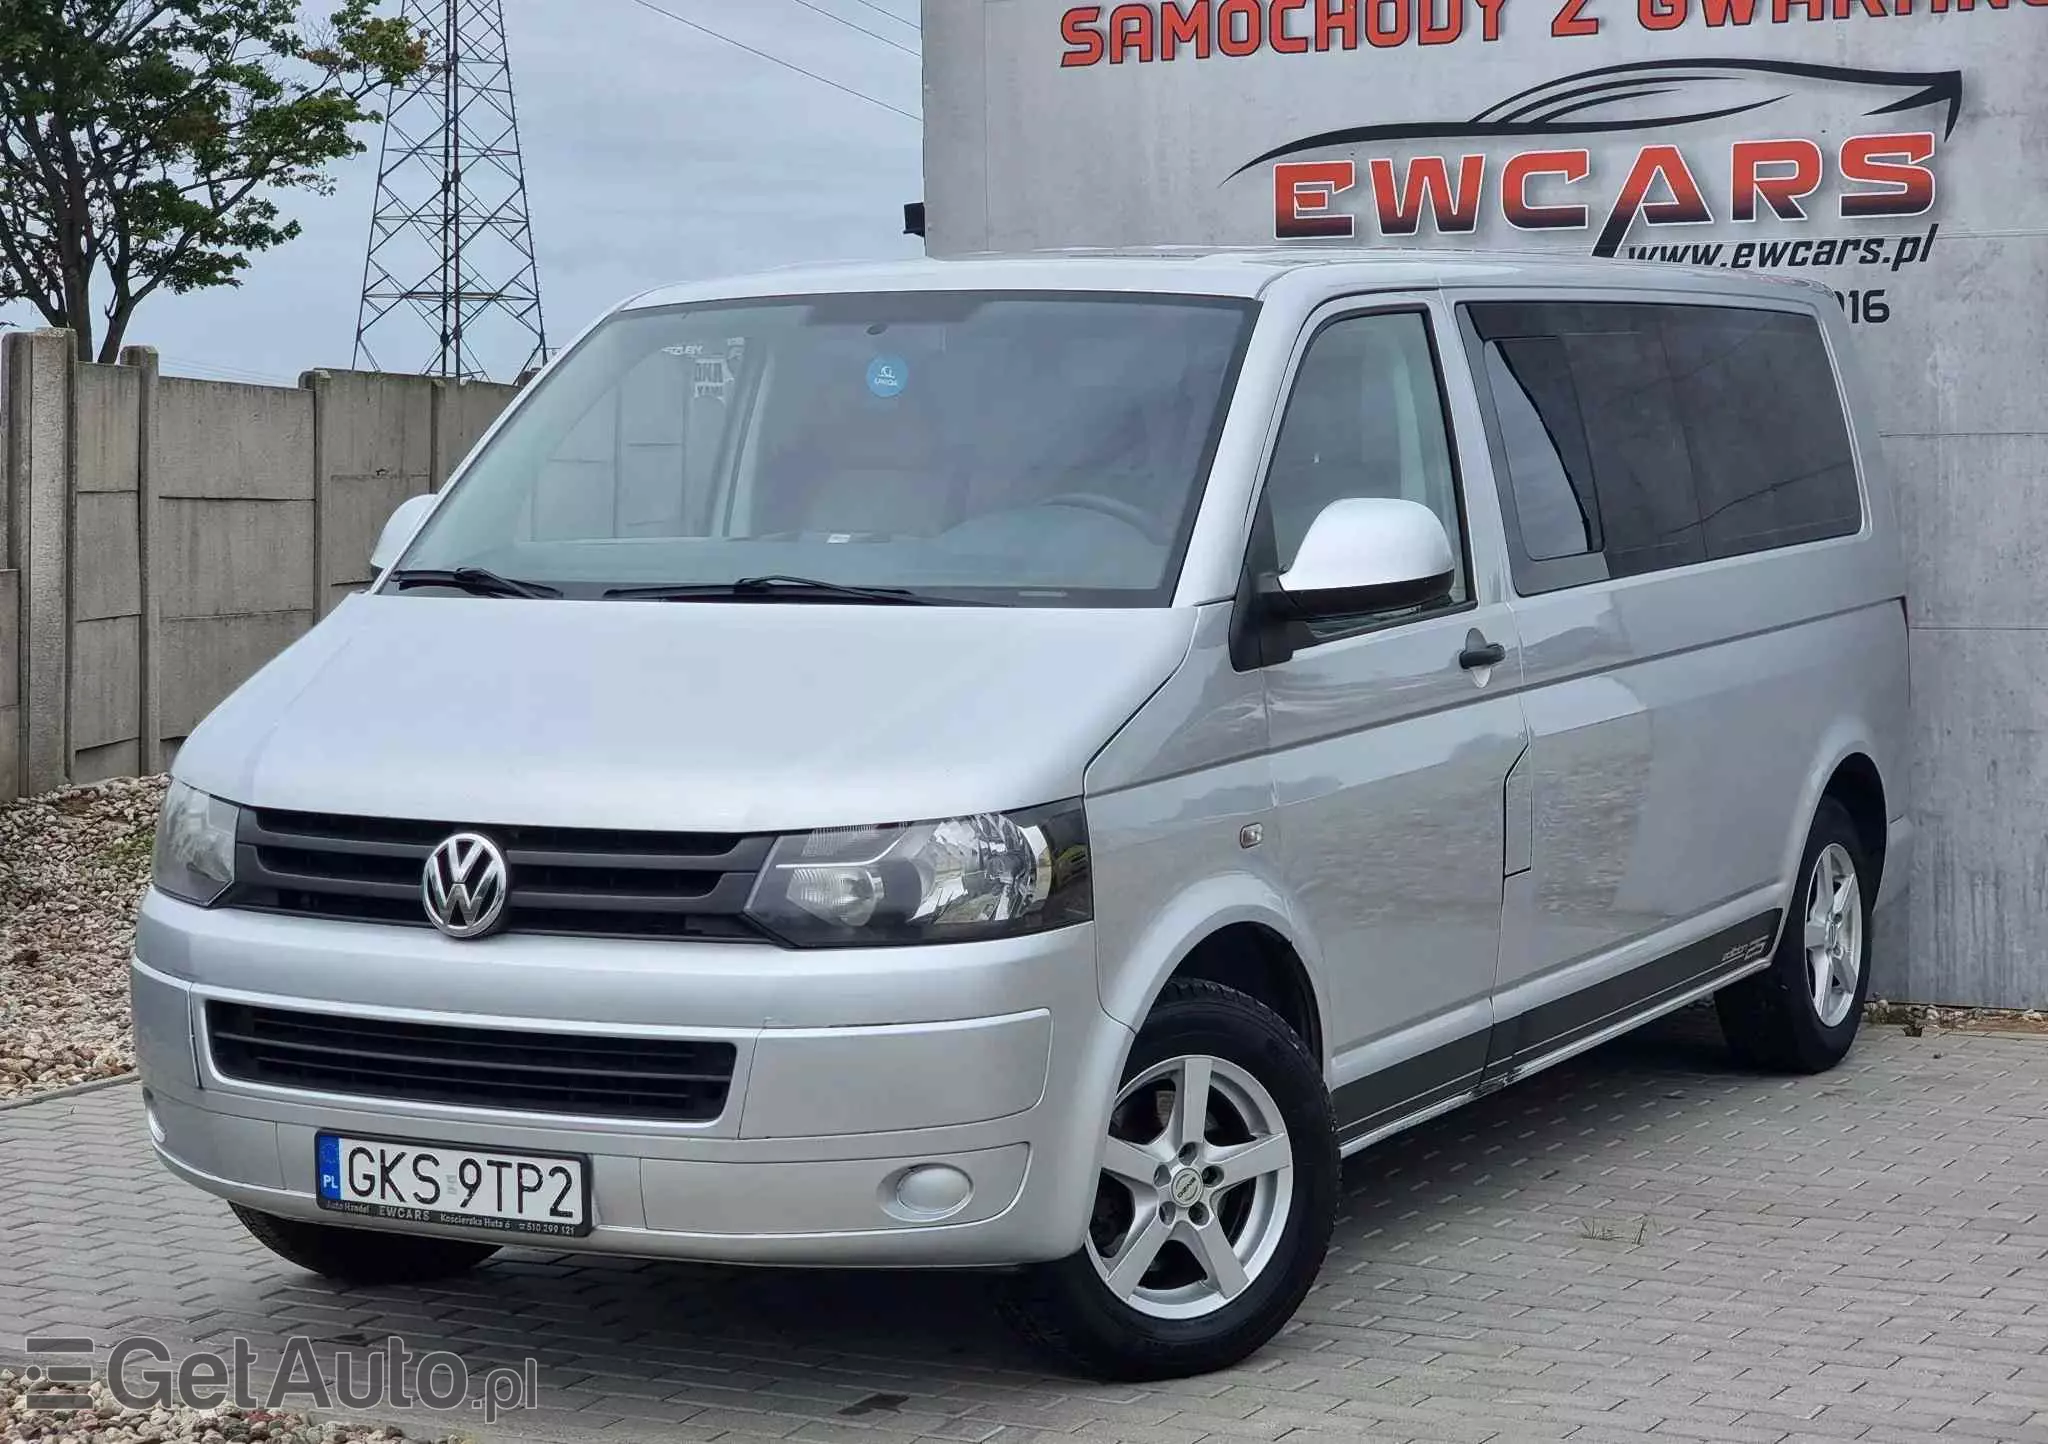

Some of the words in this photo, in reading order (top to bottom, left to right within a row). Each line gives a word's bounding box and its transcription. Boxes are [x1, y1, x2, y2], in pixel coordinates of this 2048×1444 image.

[1060, 0, 1505, 67] SAMOCHODY
[1273, 133, 1937, 257] EWCARS
[1628, 223, 1939, 272] www.ewcars.pl
[1834, 289, 1890, 324] 16
[323, 1174, 339, 1189] PL
[348, 1146, 441, 1205] GKS
[458, 1157, 574, 1219] 9TP2
[379, 1205, 431, 1221] EWCARS
